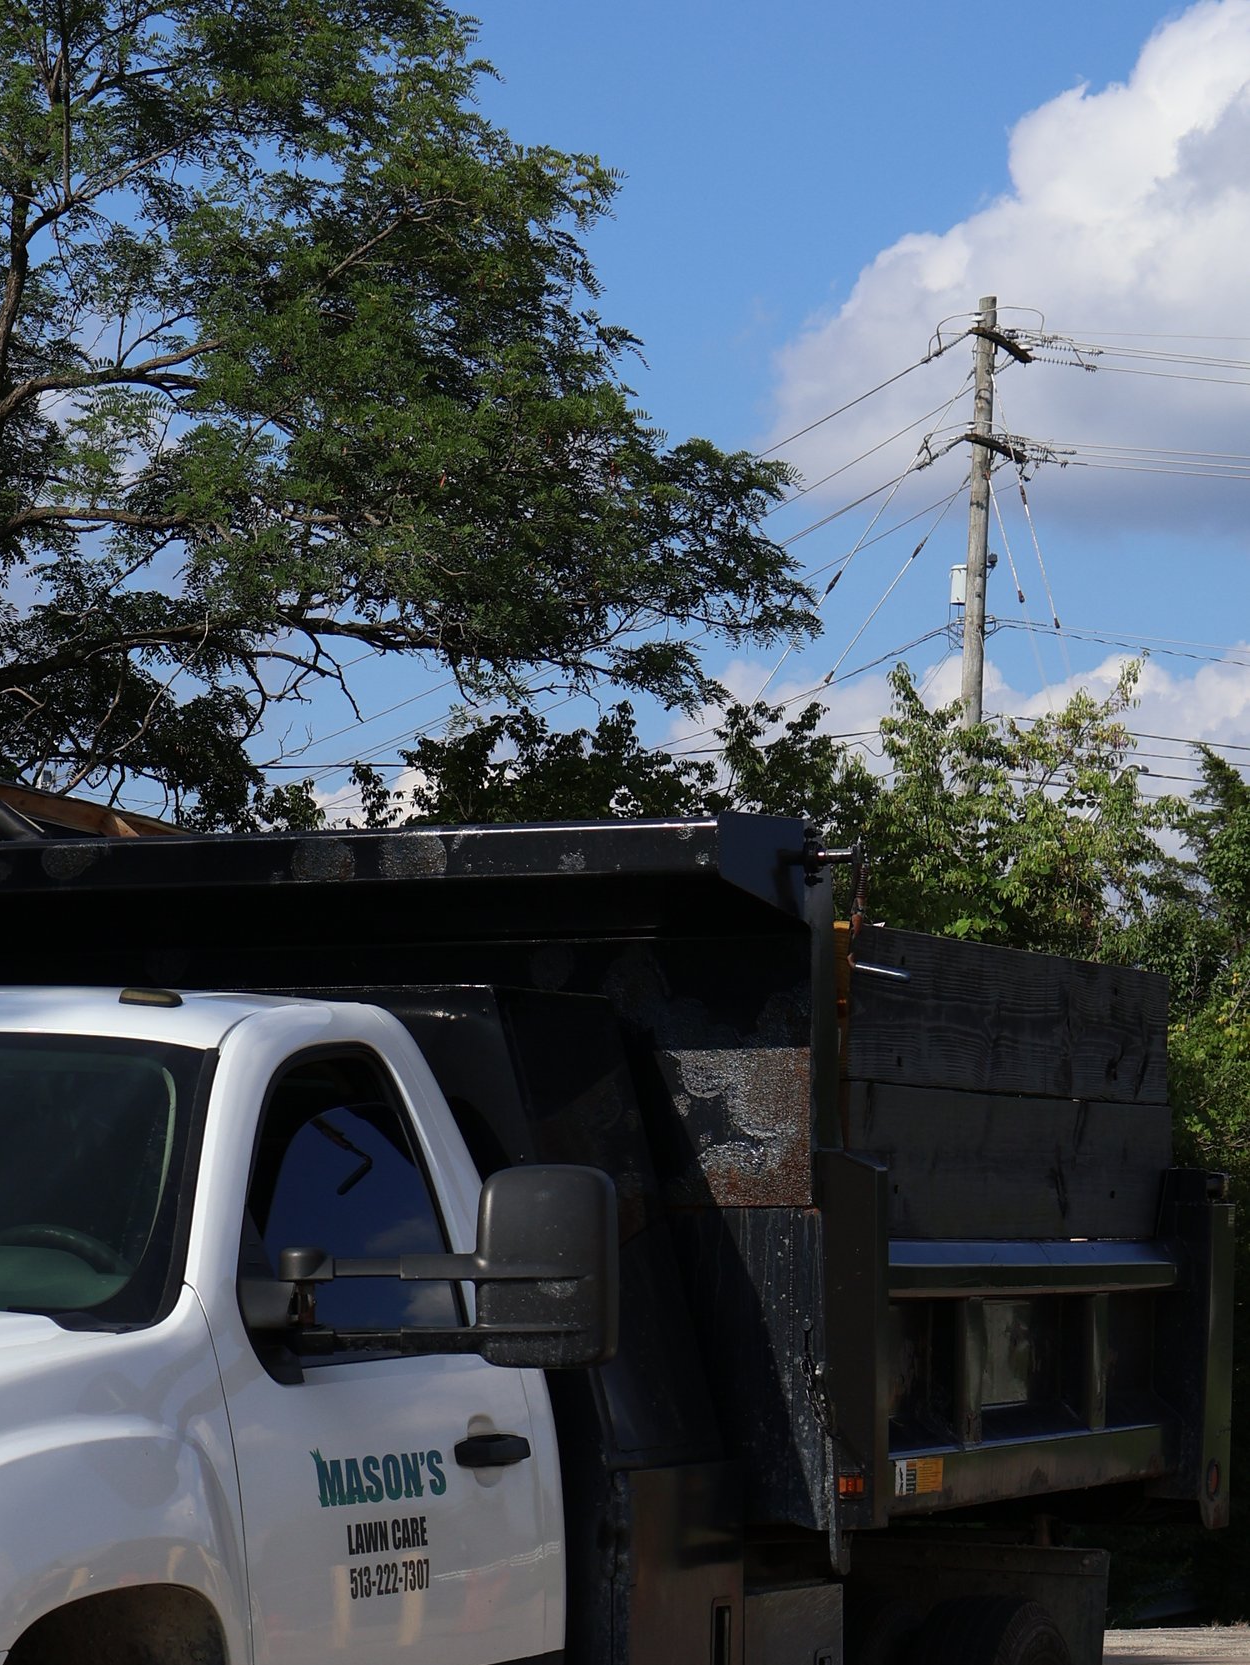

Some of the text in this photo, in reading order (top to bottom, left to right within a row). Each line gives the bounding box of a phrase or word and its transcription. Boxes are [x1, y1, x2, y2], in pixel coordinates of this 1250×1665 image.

[310, 1448, 447, 1507] MASON'S
[347, 1516, 428, 1555] LAWN CARE
[350, 1559, 430, 1600] 513-222-7307
